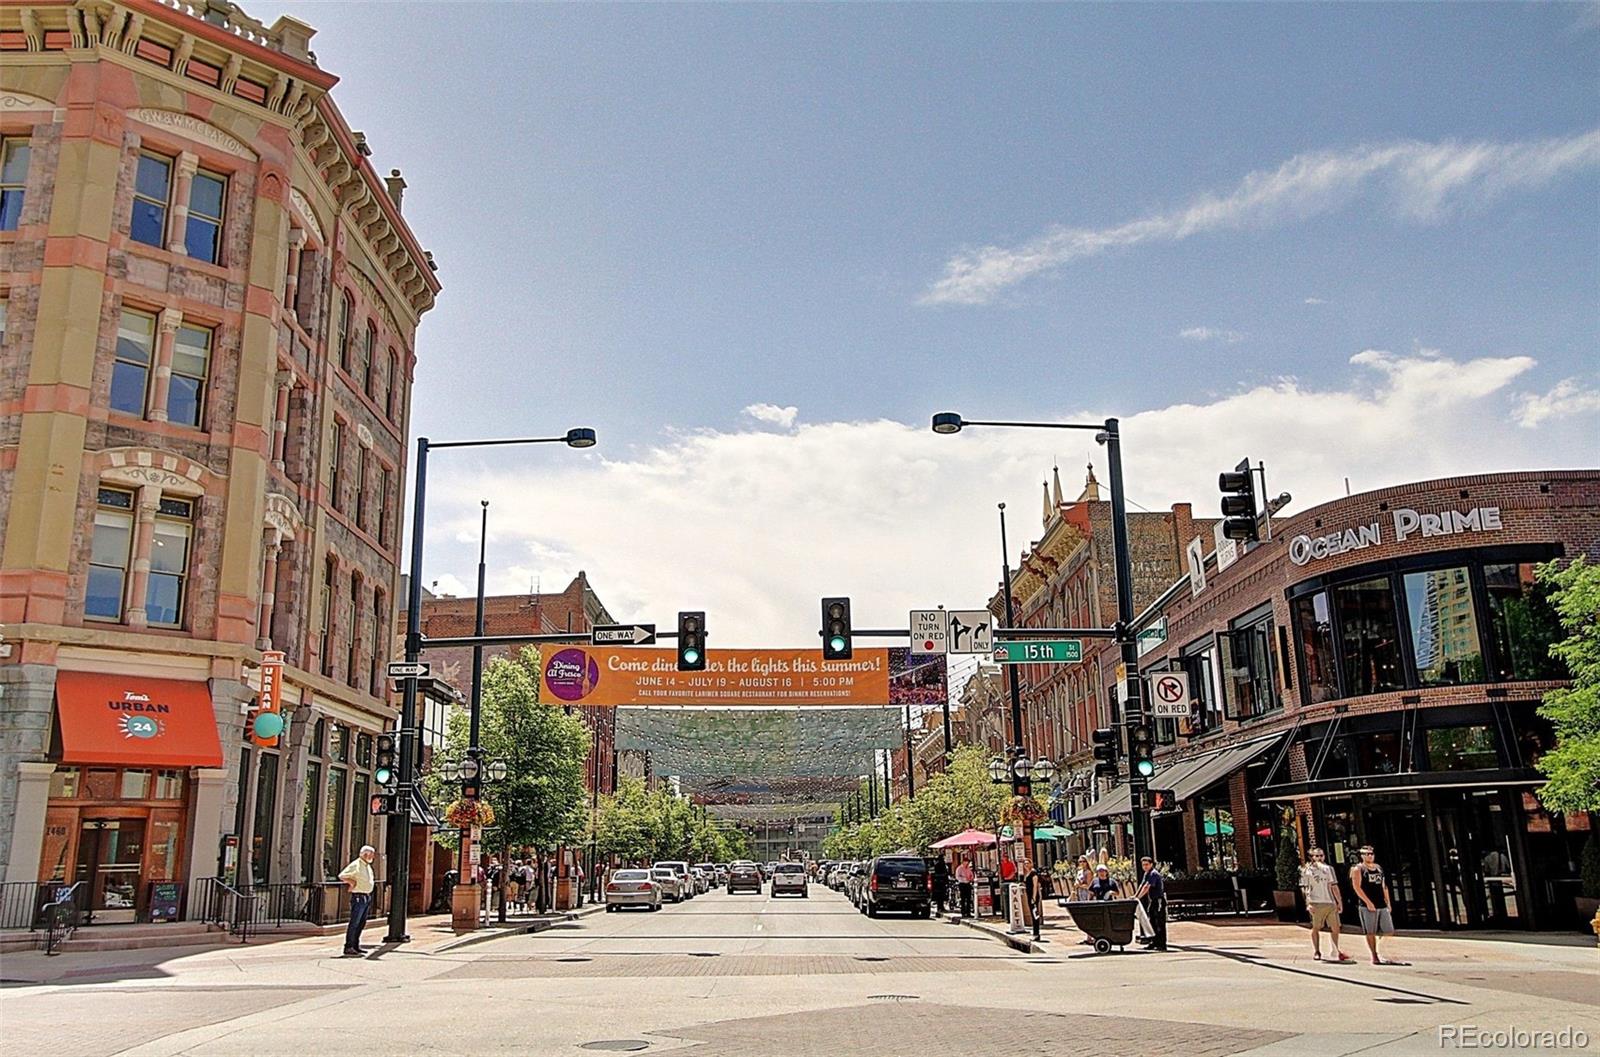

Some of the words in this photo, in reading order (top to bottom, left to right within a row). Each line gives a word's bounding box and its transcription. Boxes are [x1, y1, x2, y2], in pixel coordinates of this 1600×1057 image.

[197, 122, 243, 153] CLAYTON
[921, 613, 936, 621] NO
[918, 623, 939, 631] TURN
[597, 631, 613, 640] ONE
[618, 631, 634, 639] WAY
[913, 632, 925, 640] ON
[928, 632, 944, 640] RED
[973, 641, 989, 650] ONLY
[1024, 645, 1053, 658] 15th
[553, 660, 580, 671] Dining
[608, 655, 649, 671] Come
[727, 657, 749, 672] the
[752, 657, 789, 676] lights
[793, 657, 817, 672] this
[821, 657, 880, 672] summer!
[558, 669, 582, 678] Fresco
[636, 677, 662, 686] JUNE
[666, 677, 675, 686] 14
[688, 677, 713, 687] JULY
[716, 677, 726, 687] 19
[739, 677, 778, 687] AUGUST
[782, 677, 792, 687] 16
[813, 677, 835, 686] 5:00
[839, 677, 854, 686] PM
[262, 667, 273, 709] URBAN
[810, 689, 851, 697] RESERVATIONS!
[108, 701, 169, 713] URBAN
[1157, 705, 1169, 713] ON
[1172, 704, 1187, 713] RED
[133, 723, 152, 731] 24
[1343, 779, 1368, 788] 1465
[1011, 889, 1020, 925] VALET
